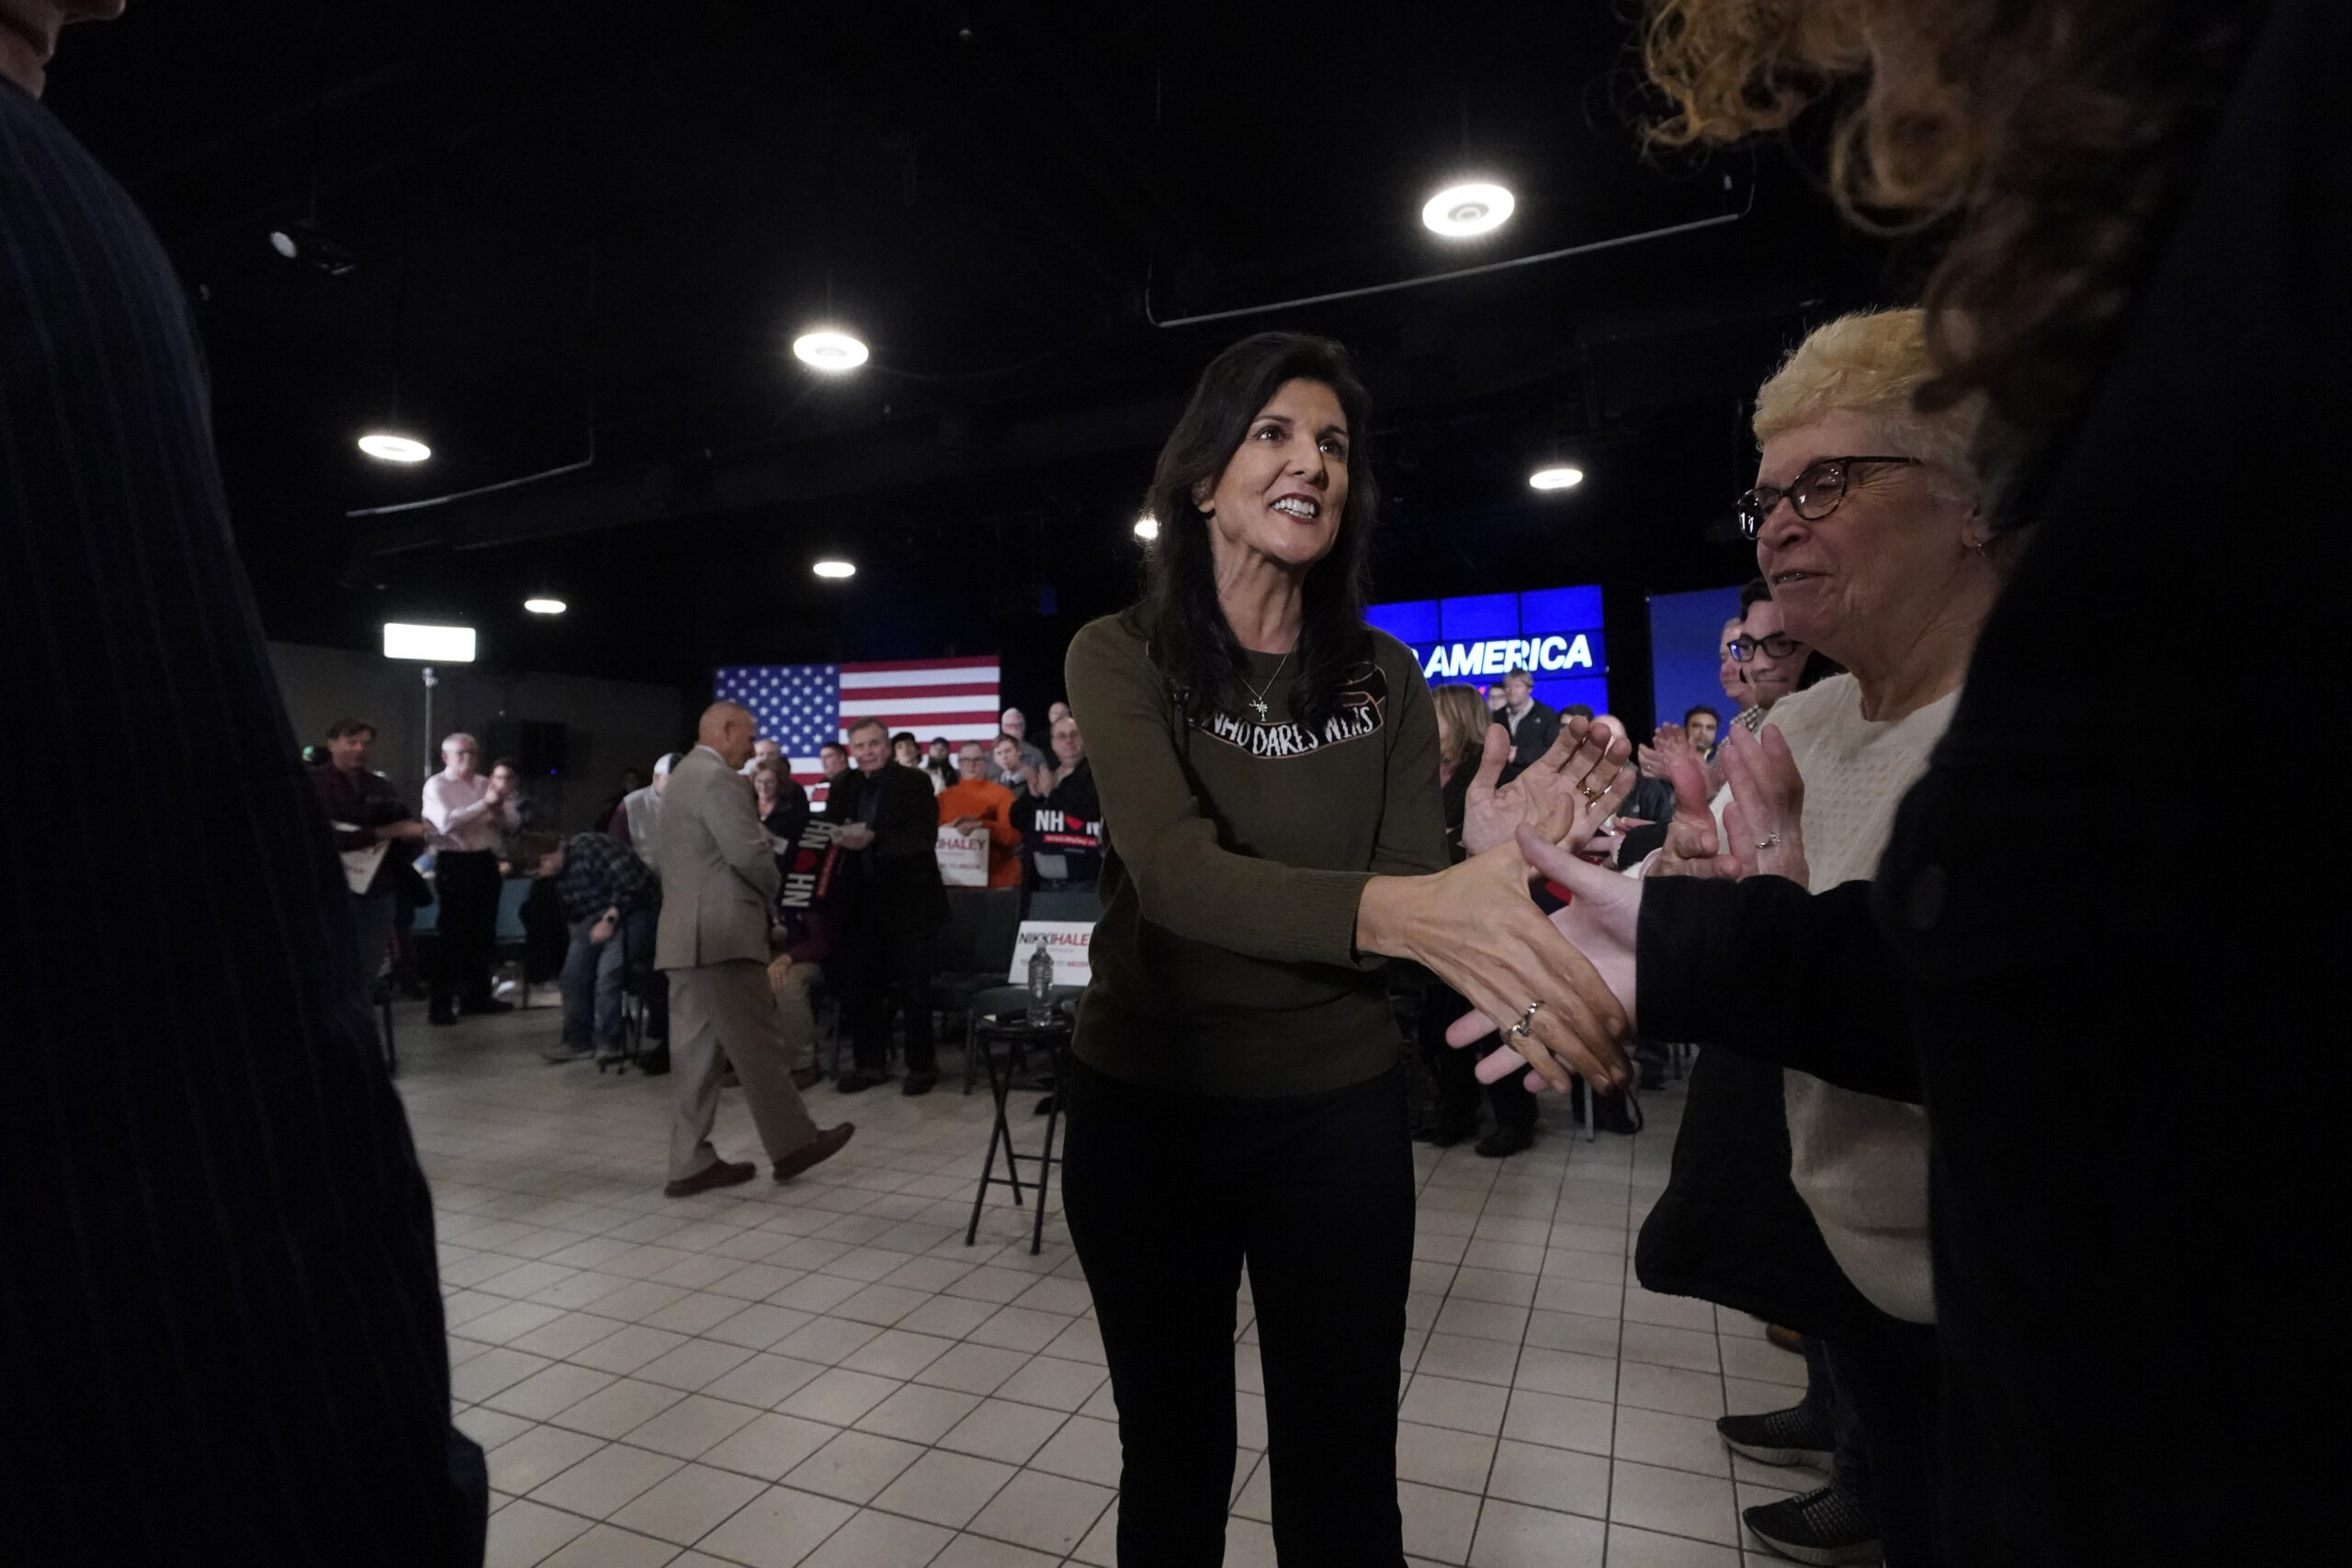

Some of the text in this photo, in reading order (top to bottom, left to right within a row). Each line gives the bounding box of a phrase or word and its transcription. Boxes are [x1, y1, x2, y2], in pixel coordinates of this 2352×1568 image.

[1424, 634, 1593, 679] AMERICA
[1035, 809, 1065, 832] NH
[781, 873, 816, 908] NH
